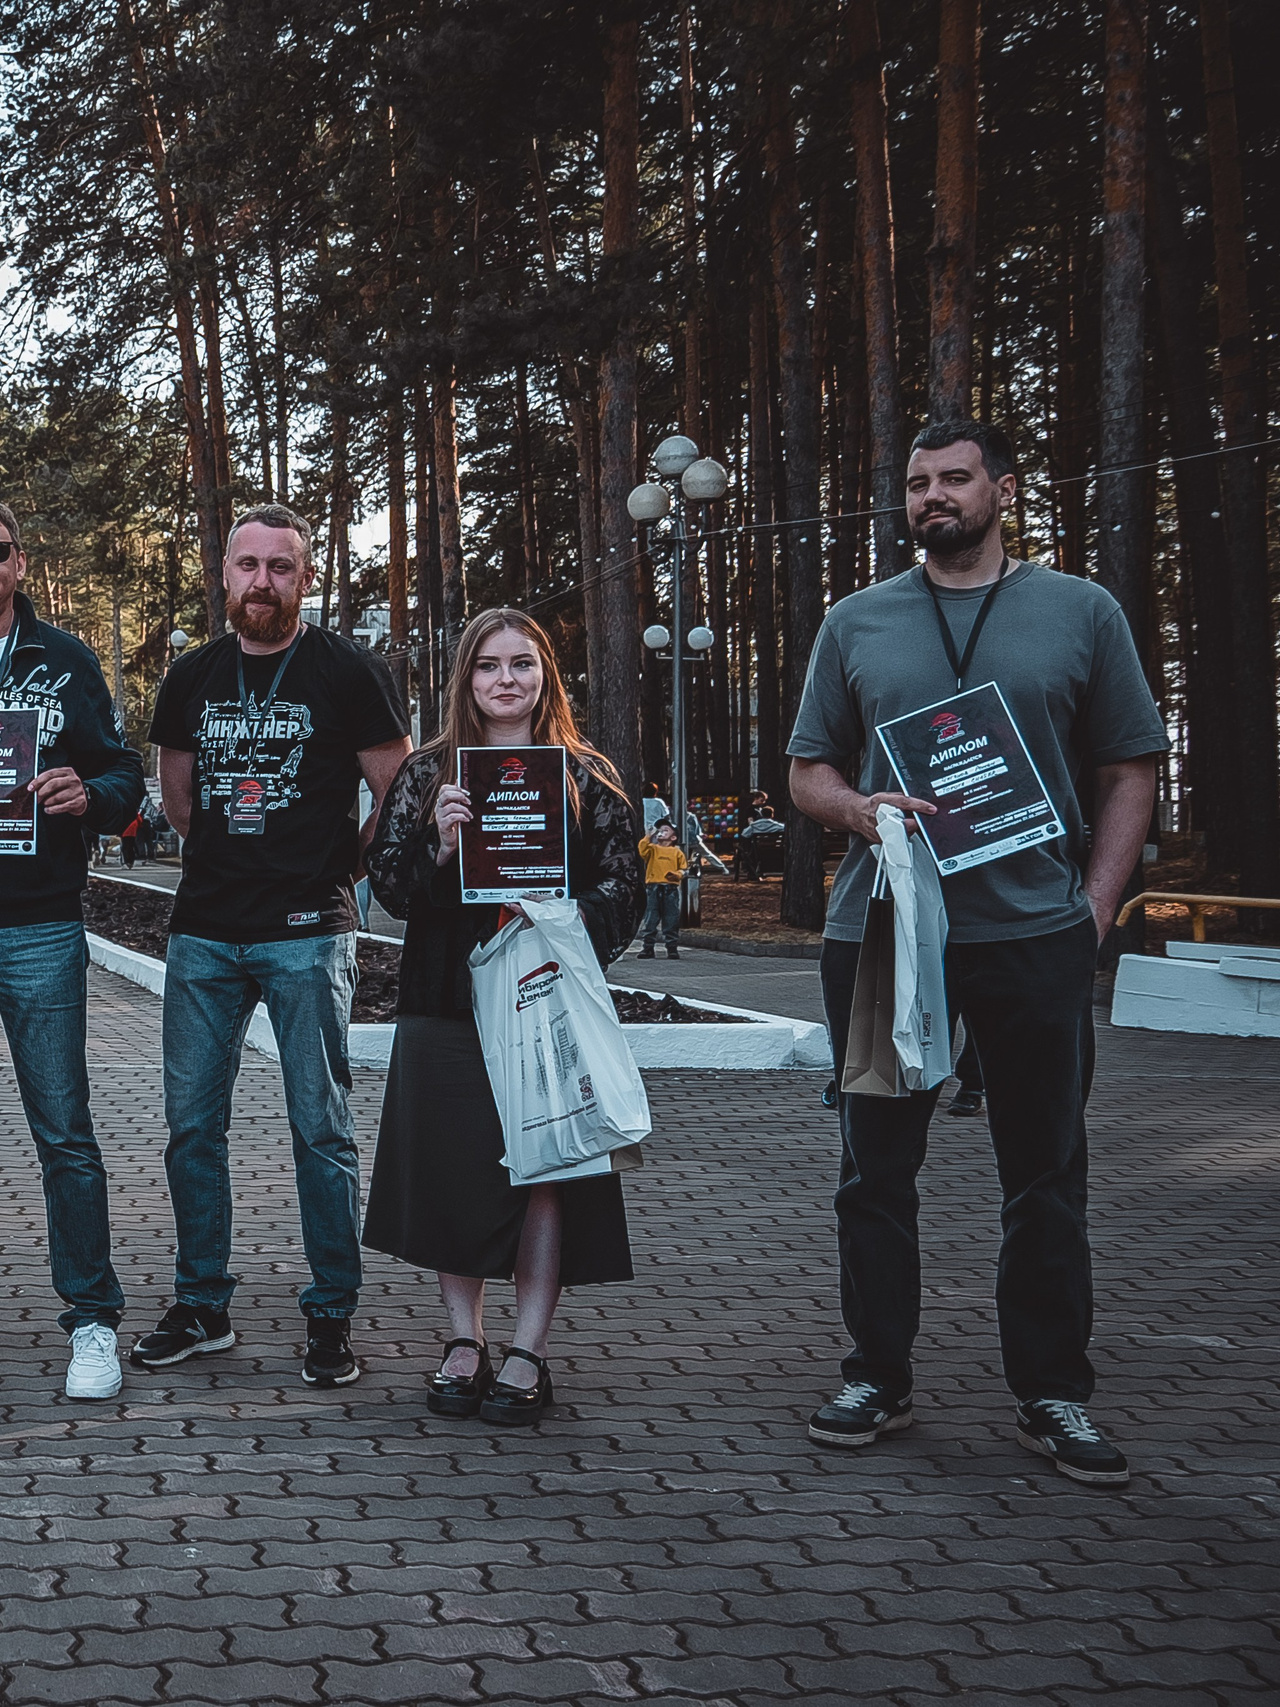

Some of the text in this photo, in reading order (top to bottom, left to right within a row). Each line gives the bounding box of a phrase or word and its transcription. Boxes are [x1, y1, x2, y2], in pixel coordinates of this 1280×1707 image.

[11, 663, 72, 697] Sail
[26, 694, 41, 704] OF
[43, 697, 62, 711] SEA
[928, 735, 989, 768] ДИПЛОМ
[486, 790, 540, 803] ДИПЛОМ
